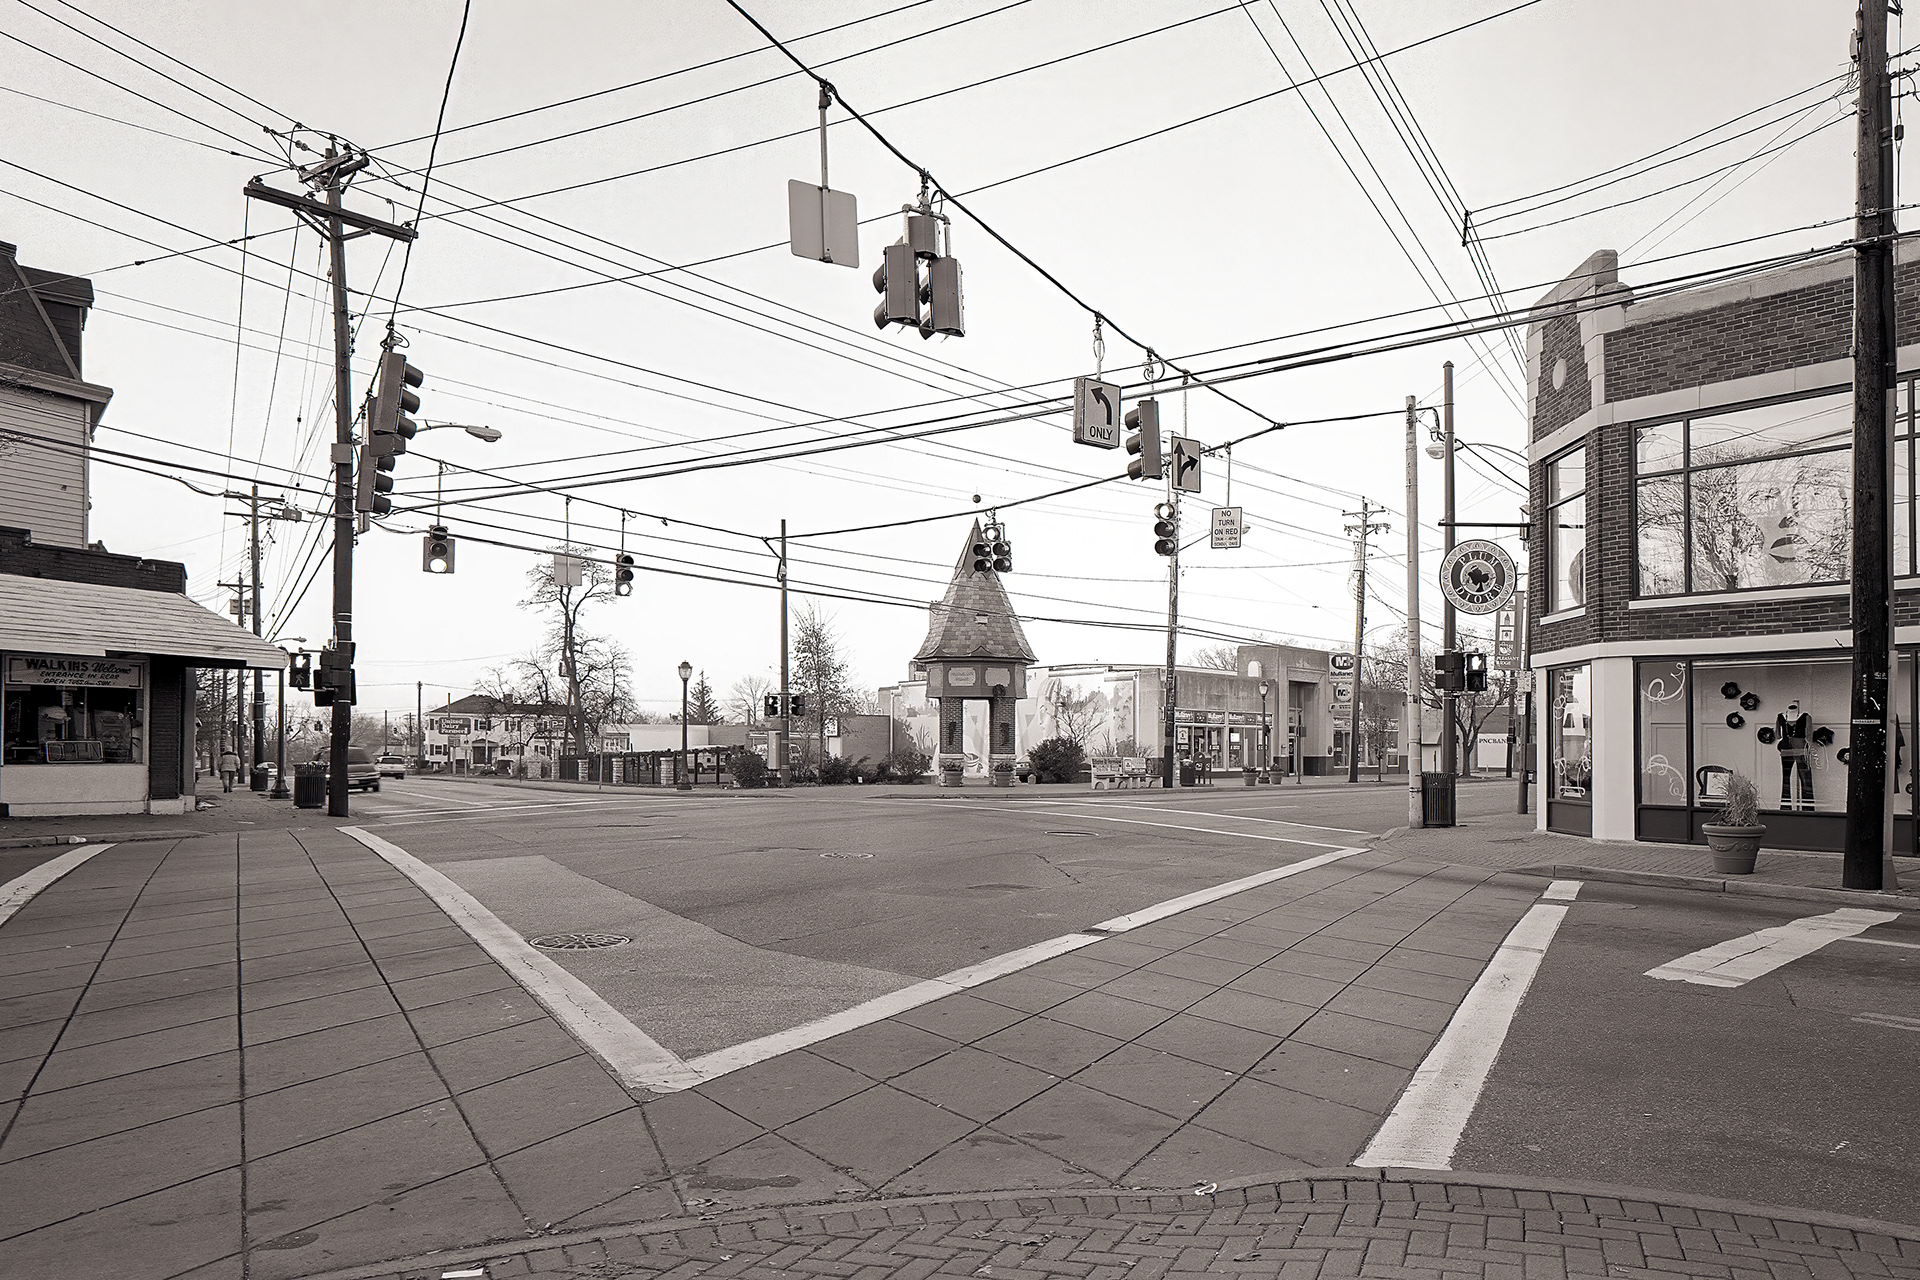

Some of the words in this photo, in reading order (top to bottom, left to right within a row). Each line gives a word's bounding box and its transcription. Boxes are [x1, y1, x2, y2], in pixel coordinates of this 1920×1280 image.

[1090, 426, 1113, 440] ONLY
[1458, 552, 1499, 567] PLUM
[40, 670, 84, 679] ENTRANCE
